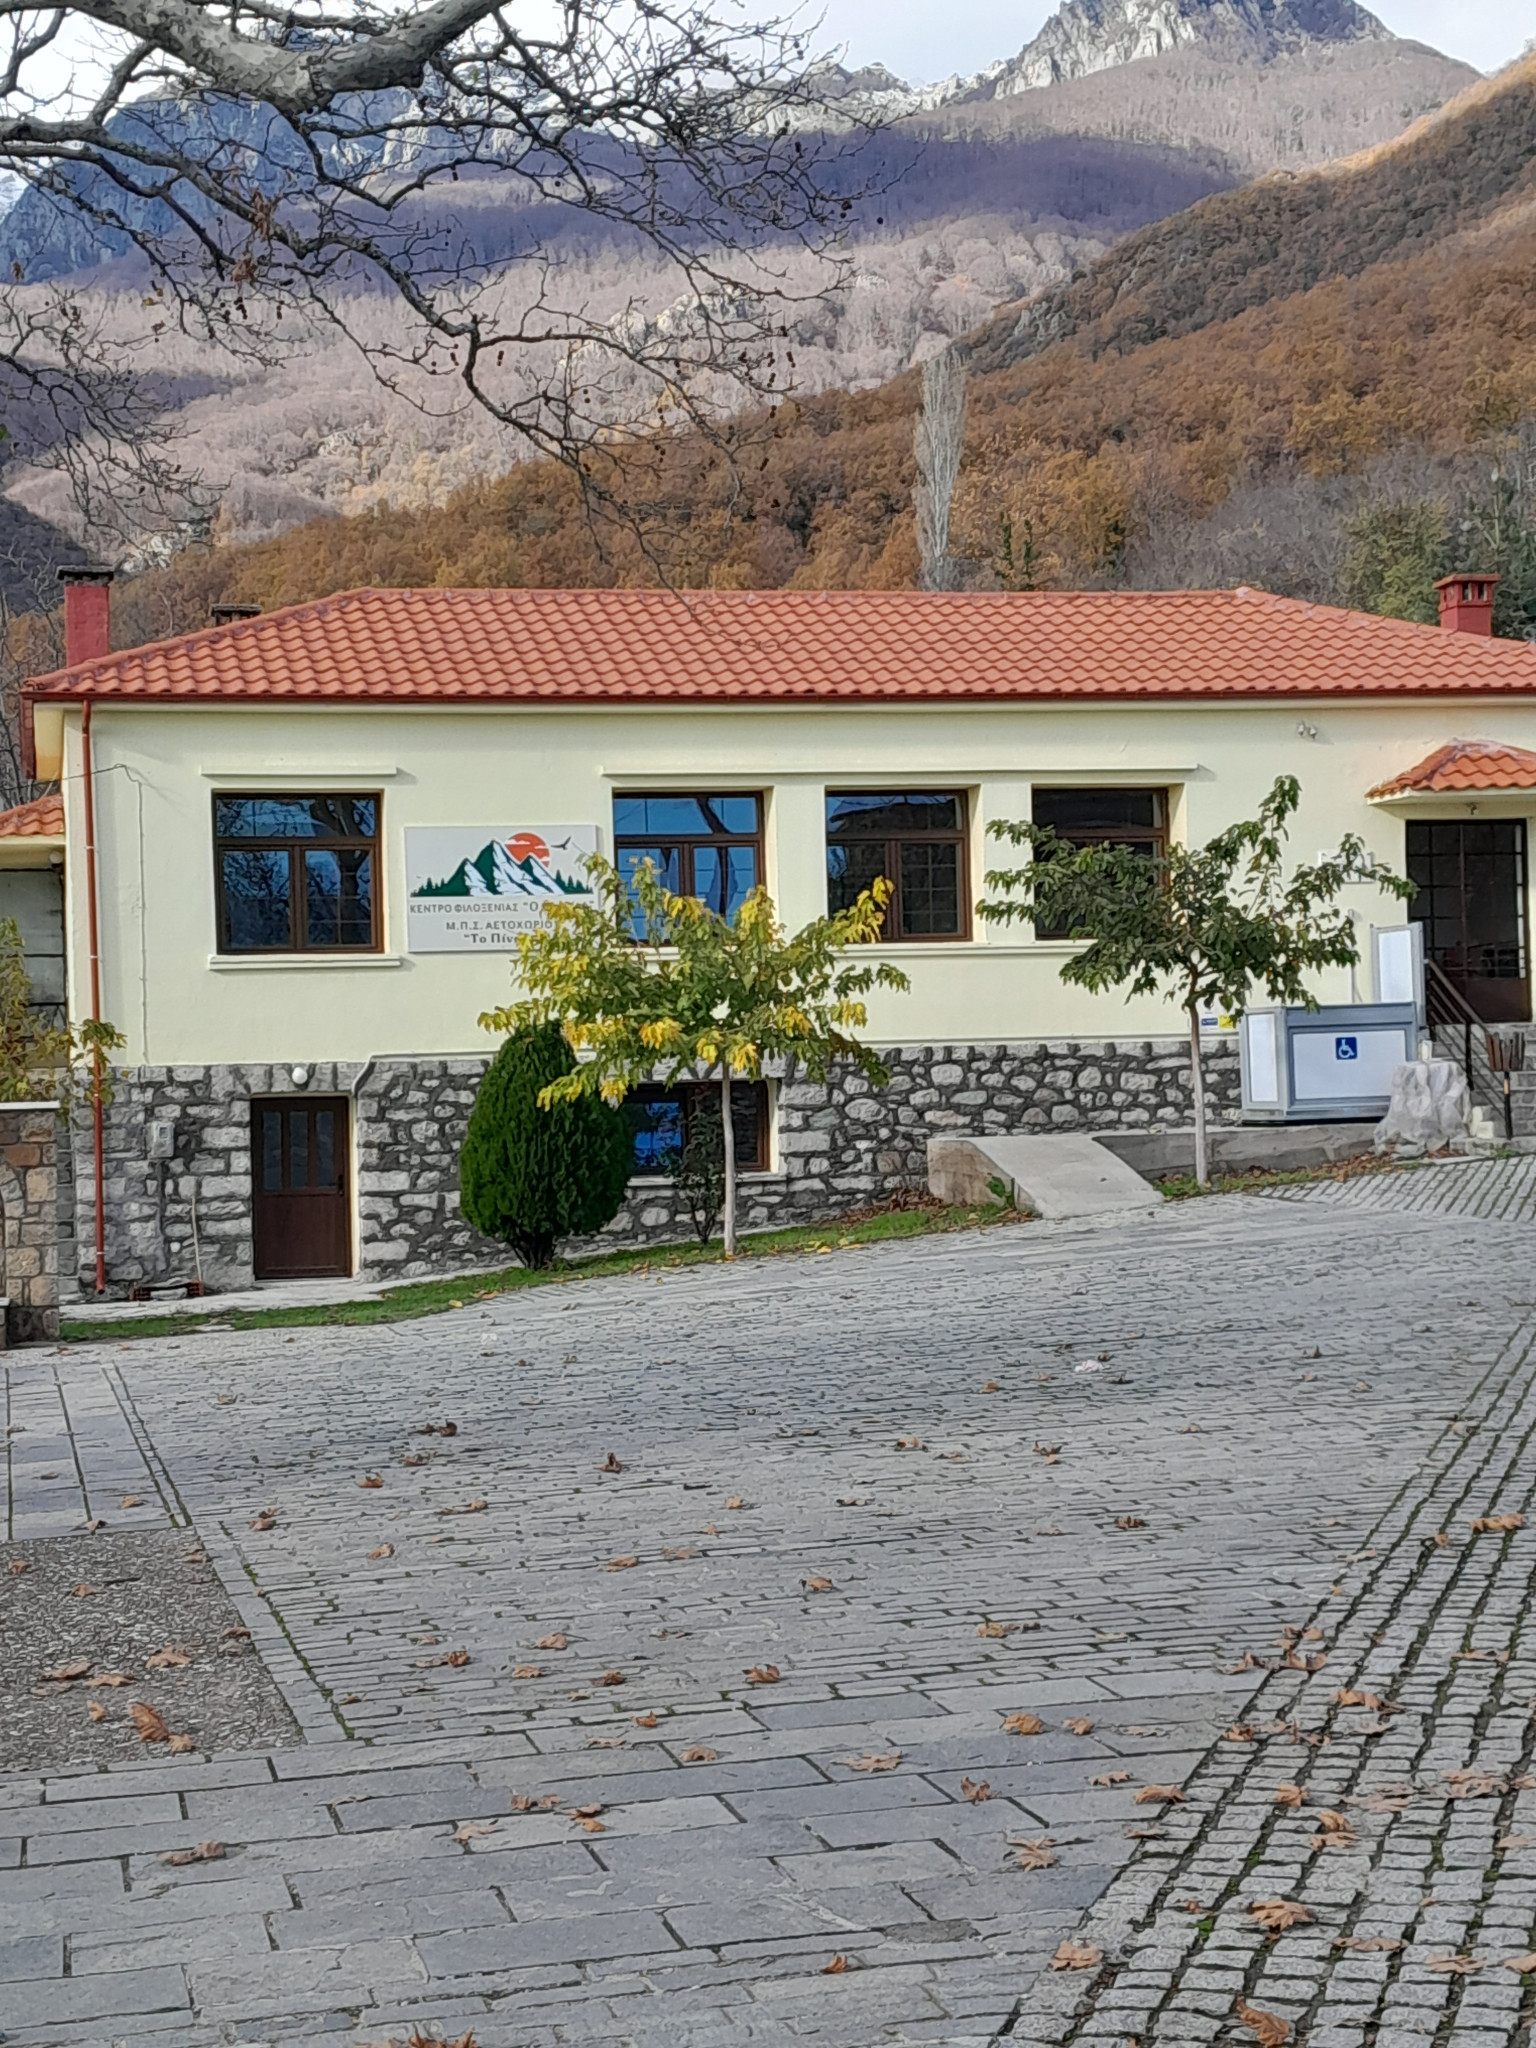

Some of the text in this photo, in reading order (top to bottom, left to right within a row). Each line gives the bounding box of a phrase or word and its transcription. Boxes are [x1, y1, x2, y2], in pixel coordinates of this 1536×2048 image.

[410, 904, 452, 914] ΚΕΝΤΡΟ
[454, 903, 519, 913] ΦΙΛΟΞΕΝΙΑΣ
[485, 920, 559, 930] ΑΕΤΟΧΩΡΙΟ
